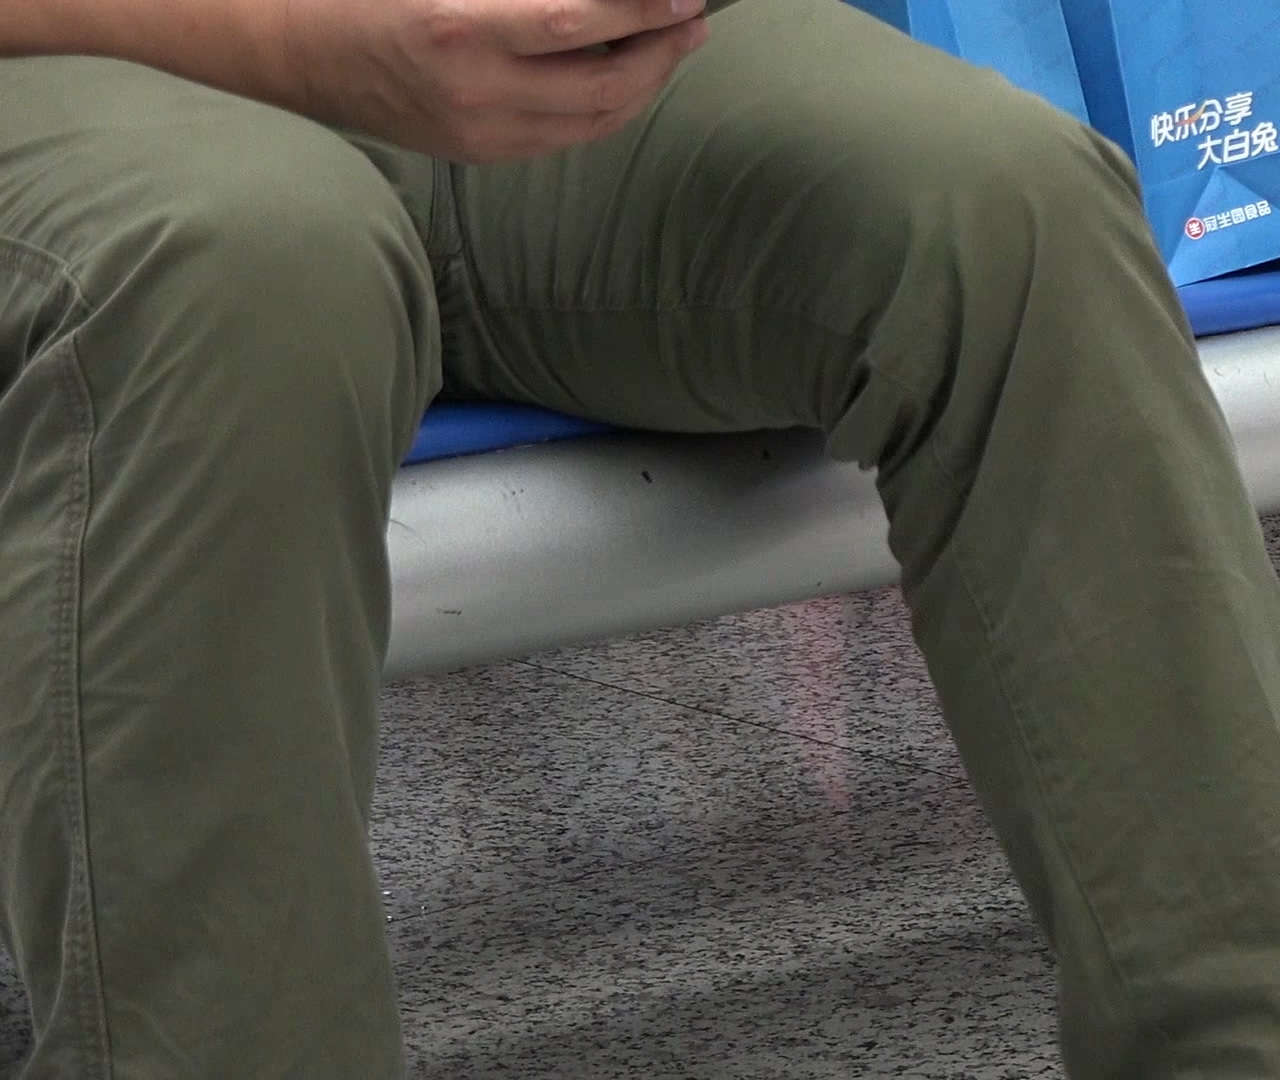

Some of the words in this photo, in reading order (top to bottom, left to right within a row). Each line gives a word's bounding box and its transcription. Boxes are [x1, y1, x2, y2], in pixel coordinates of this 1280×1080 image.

[1151, 91, 1253, 148] 快乐分享
[1197, 121, 1279, 170] 大白兔
